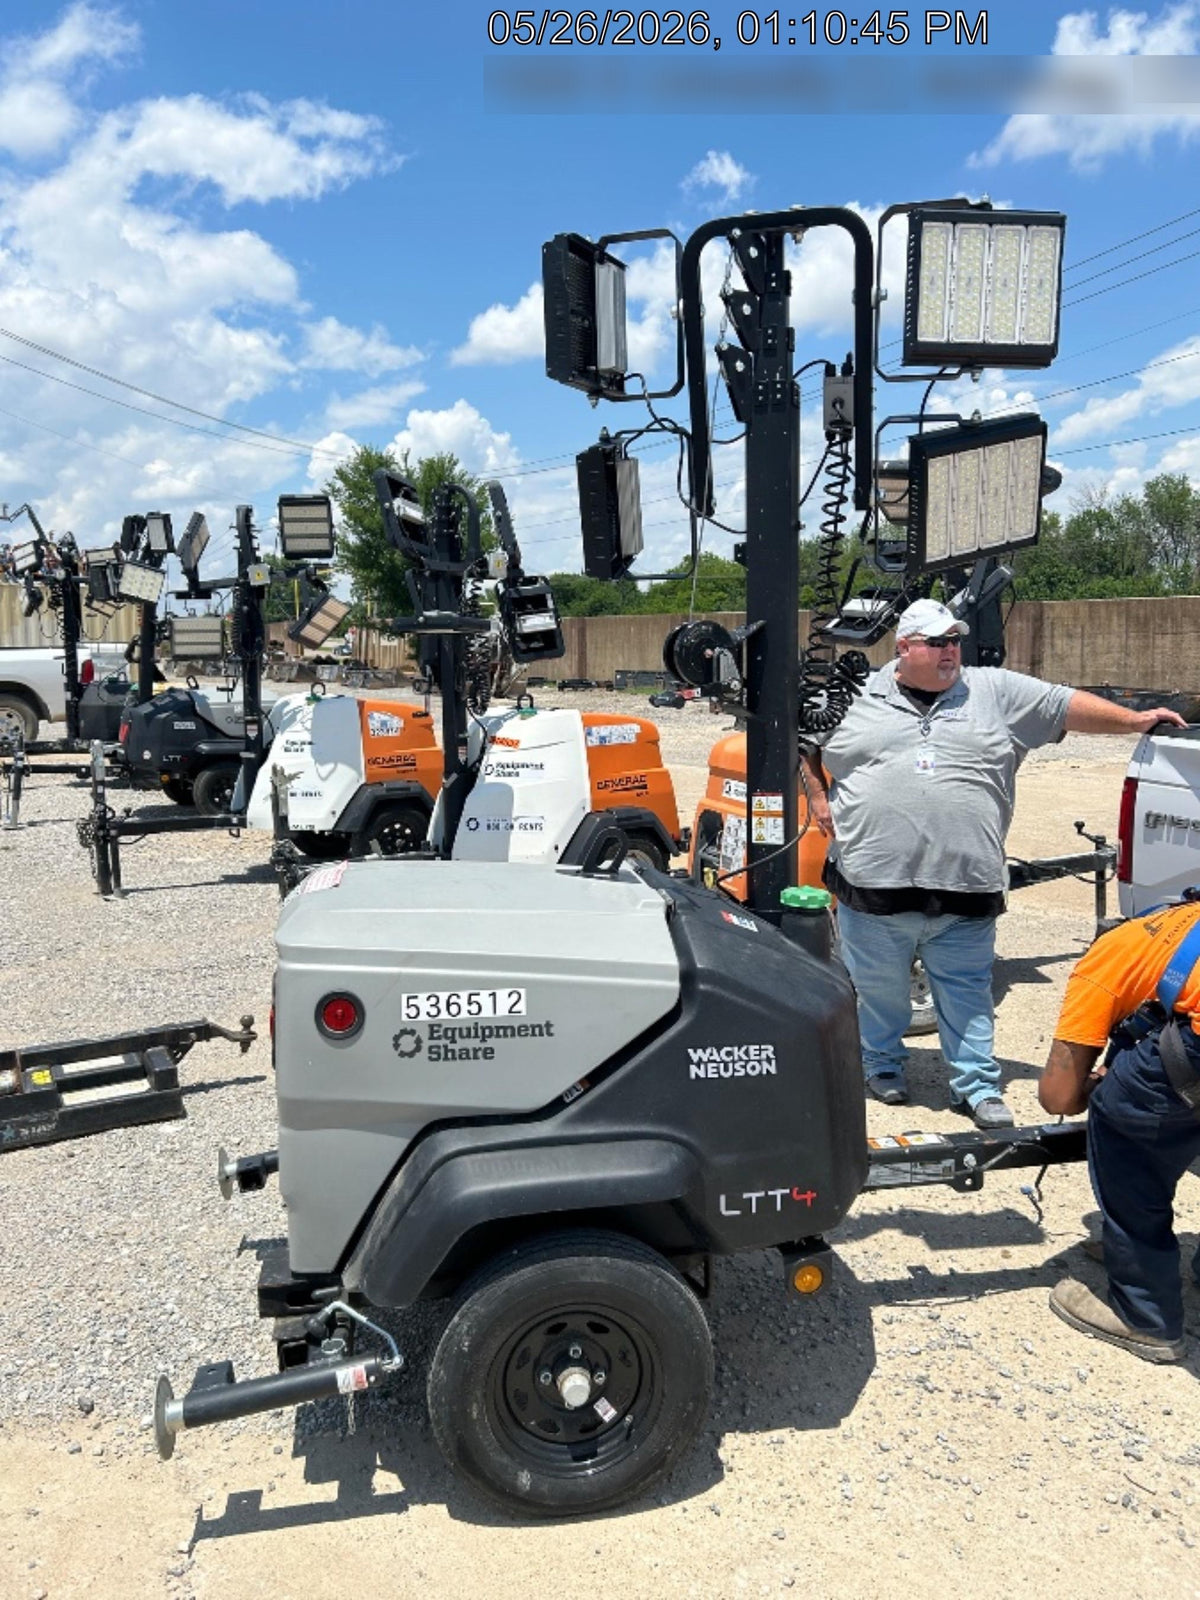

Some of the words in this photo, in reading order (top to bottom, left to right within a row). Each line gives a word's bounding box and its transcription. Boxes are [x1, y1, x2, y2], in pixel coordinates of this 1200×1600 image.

[597, 774, 647, 791] GENERAC
[404, 989, 523, 1020] 536512
[427, 1020, 555, 1045] Equipment
[427, 1043, 496, 1062] Share
[687, 1044, 776, 1063] WACKER
[689, 1059, 778, 1080] NEUSON
[719, 1186, 817, 1217] LTT4
